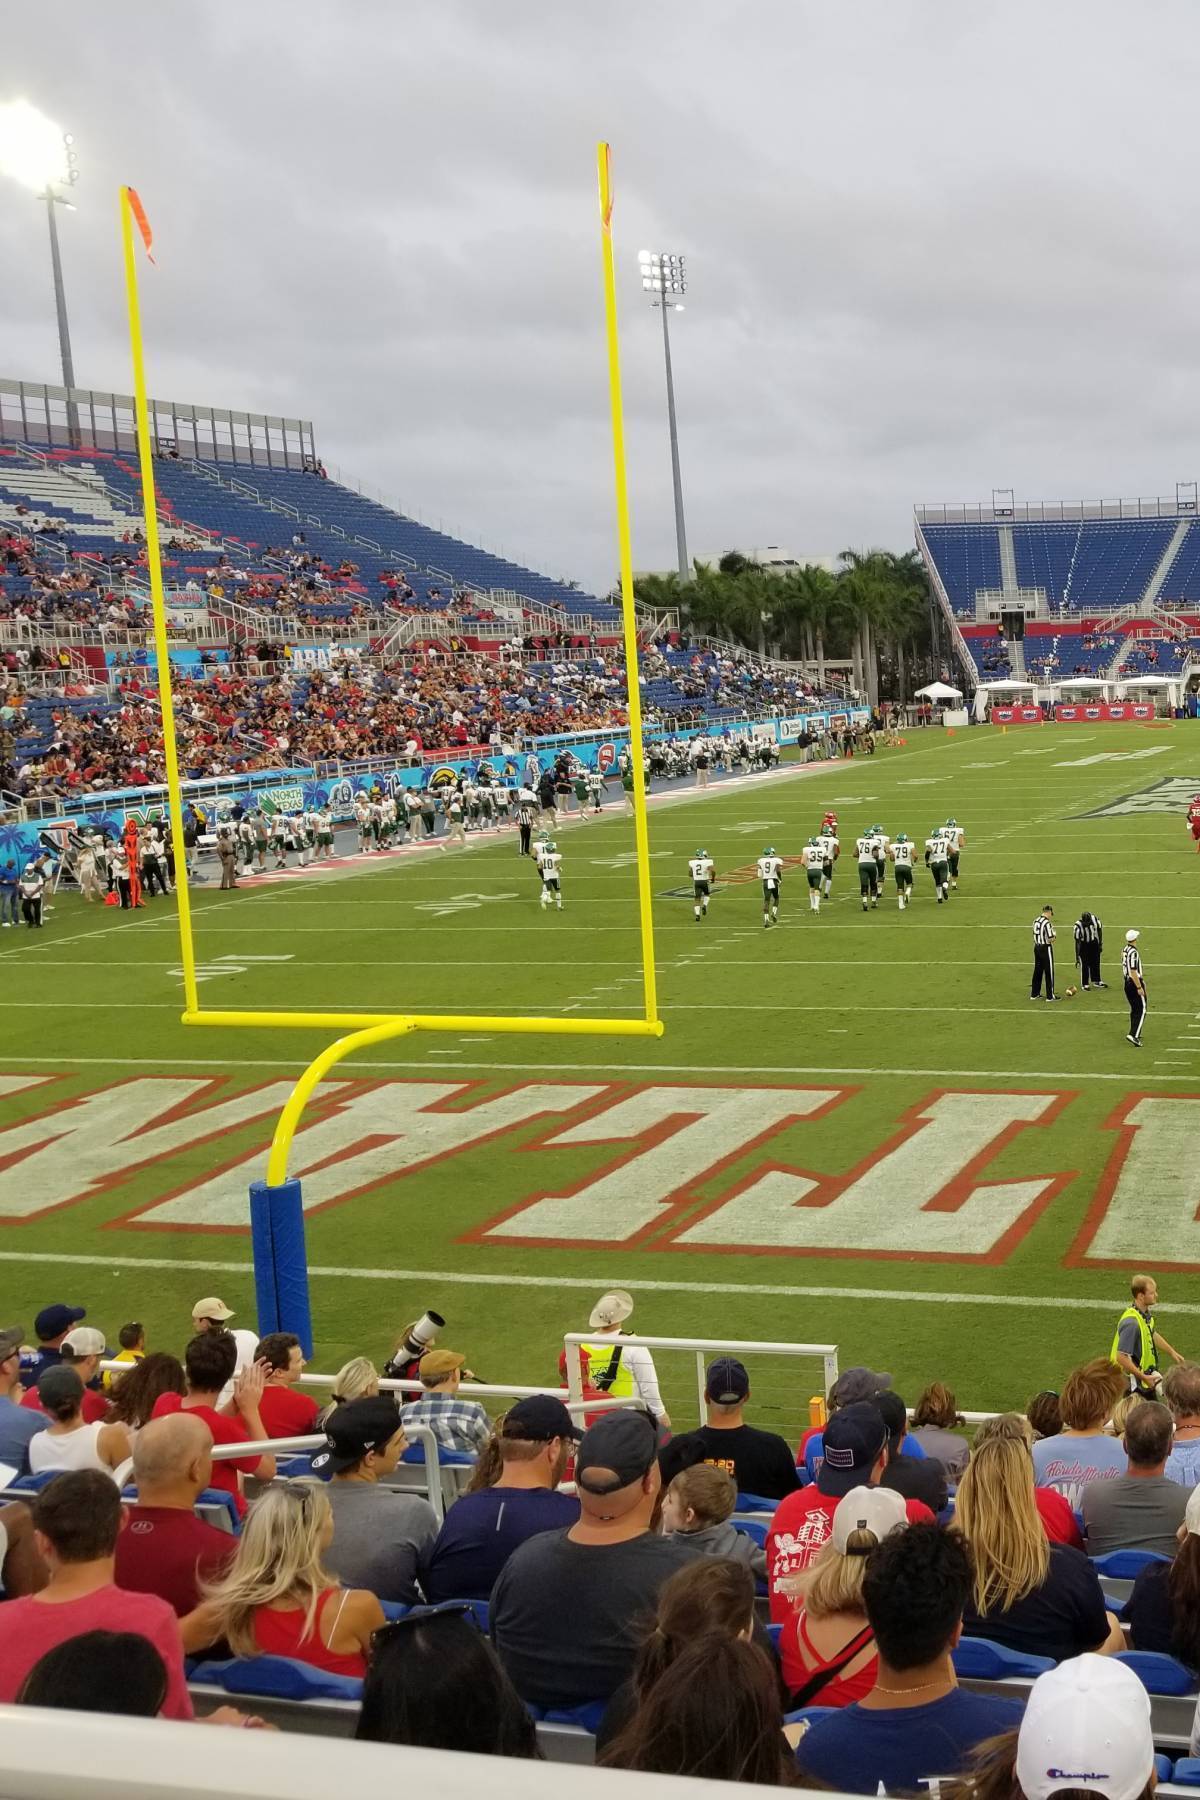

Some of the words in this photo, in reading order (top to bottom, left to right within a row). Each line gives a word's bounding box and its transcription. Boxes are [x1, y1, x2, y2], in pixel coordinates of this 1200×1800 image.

[272, 788, 302, 801] NORTH
[277, 800, 303, 811] TEXAS
[944, 830, 955, 842] 67
[859, 842, 870, 854] 76
[895, 846, 908, 858] 79
[933, 842, 946, 854] 77
[810, 851, 823, 862] 35
[543, 858, 554, 870] 10
[696, 864, 702, 875] 2
[765, 862, 770, 874] 9
[1045, 1459, 1081, 1478] Florida
[1047, 1768, 1110, 1782] Champion
